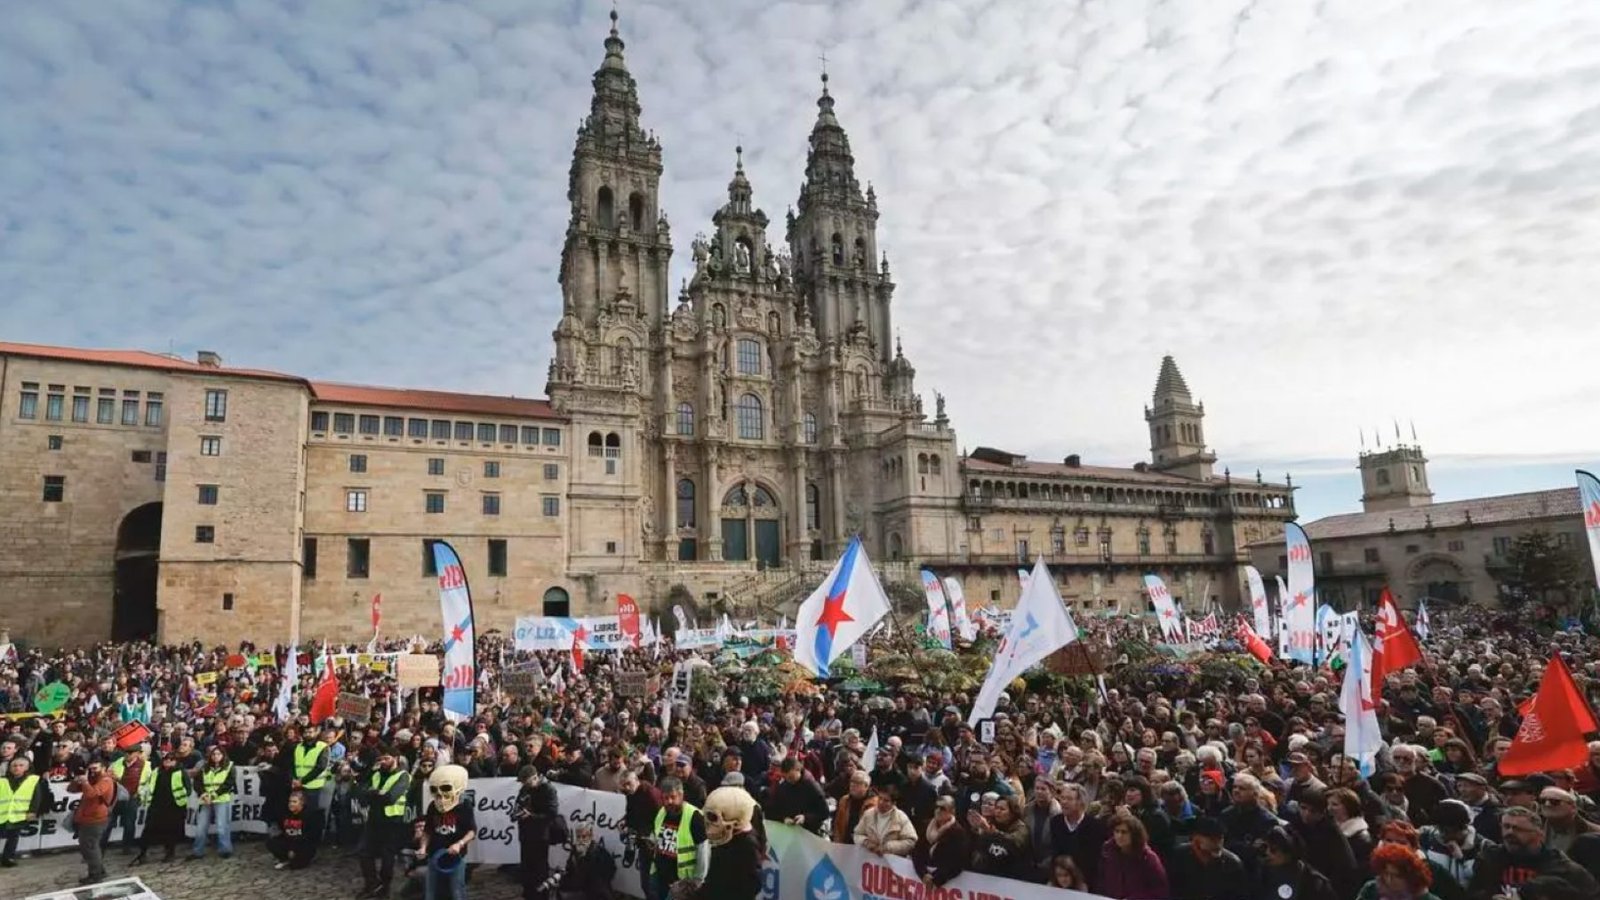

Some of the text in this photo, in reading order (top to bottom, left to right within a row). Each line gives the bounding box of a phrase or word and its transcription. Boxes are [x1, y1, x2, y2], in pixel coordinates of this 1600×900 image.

[594, 623, 618, 632] LIBRE
[594, 635, 605, 643] DE
[570, 801, 621, 830] adeu
